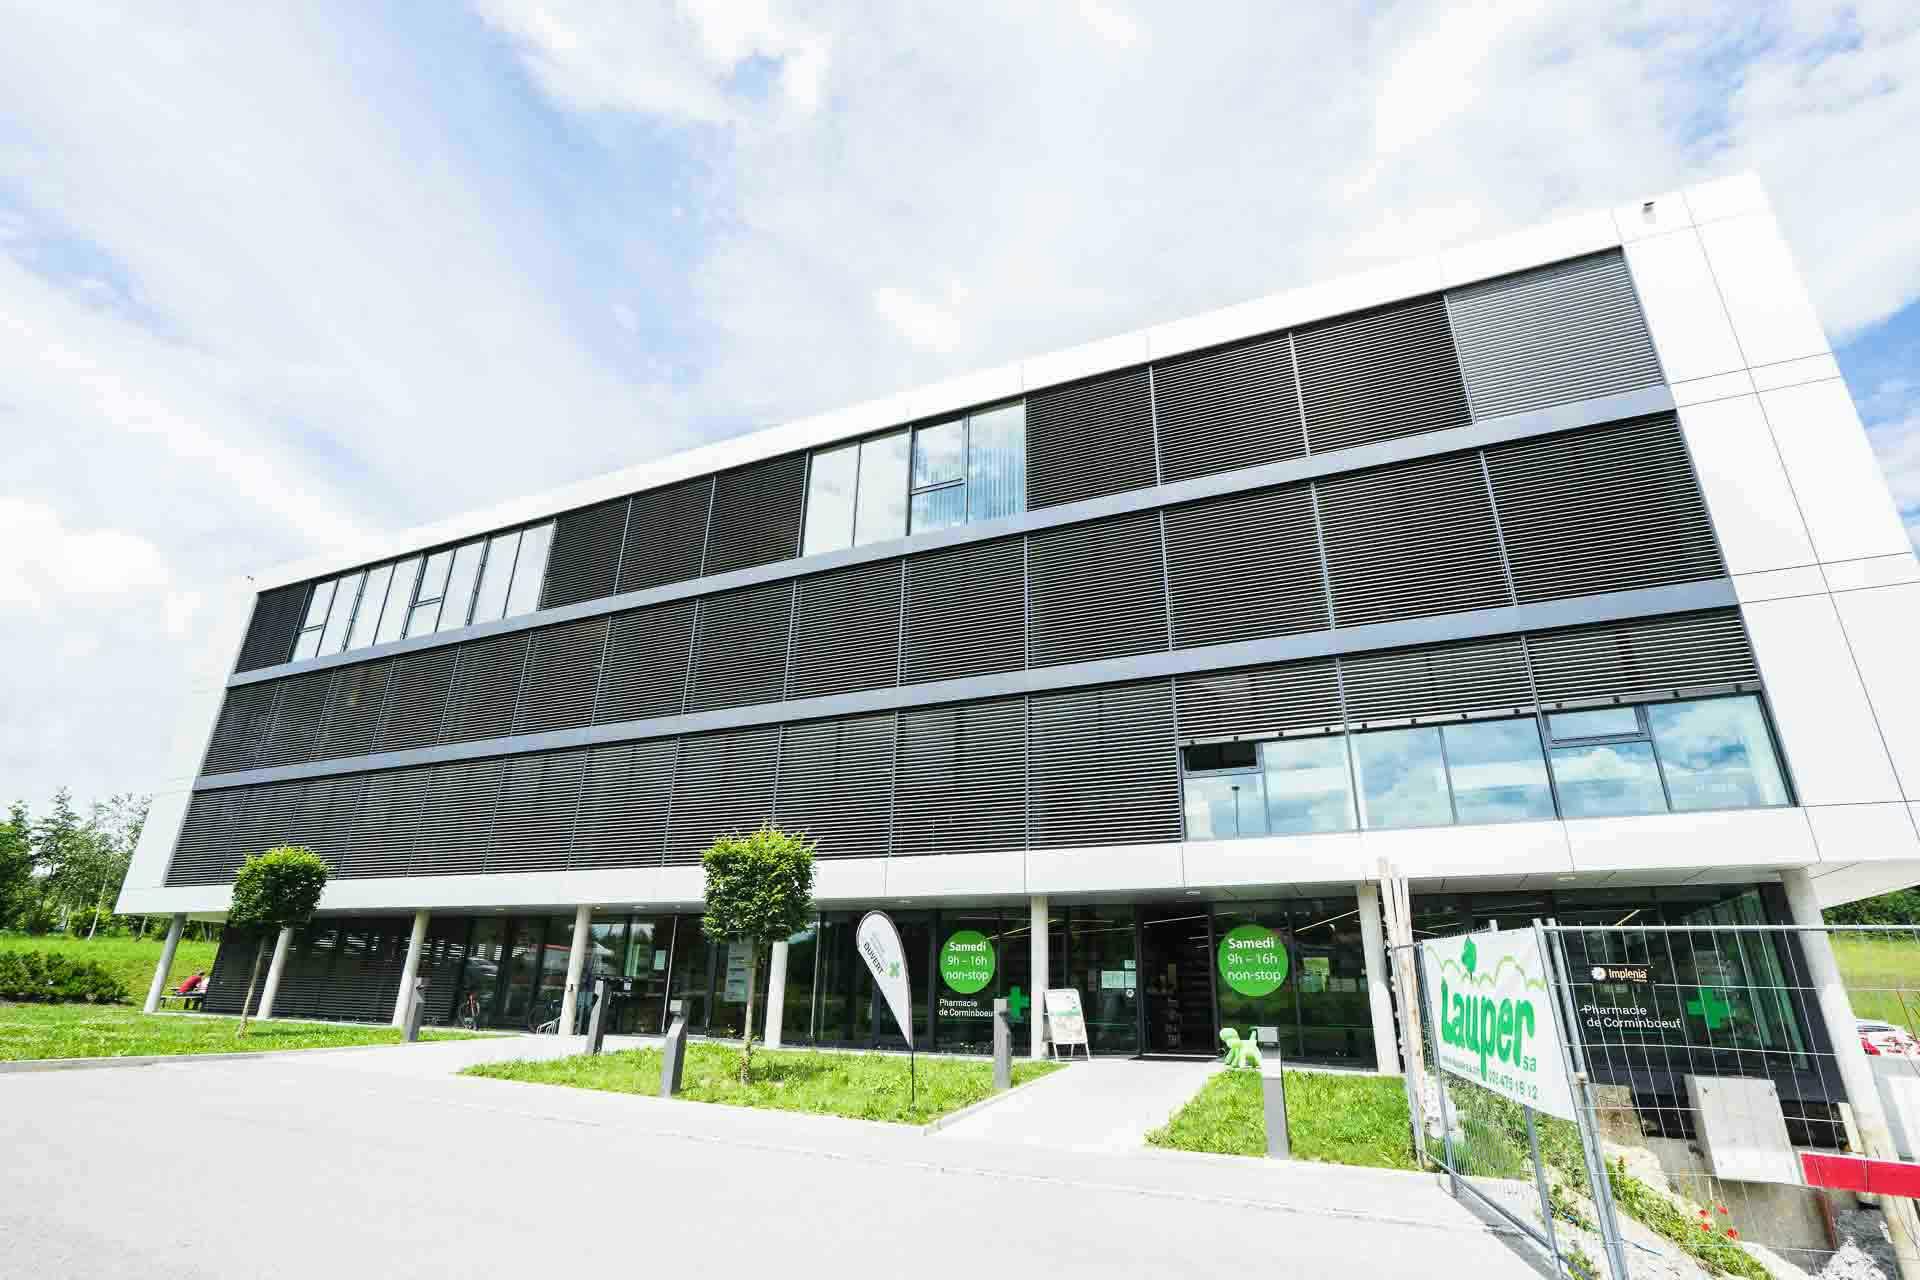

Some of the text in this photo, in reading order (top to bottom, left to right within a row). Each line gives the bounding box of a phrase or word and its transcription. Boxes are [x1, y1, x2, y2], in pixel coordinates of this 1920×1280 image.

[949, 942, 987, 951] Samedi
[1228, 937, 1275, 949] Samedi
[864, 942, 884, 975] OUVERT
[947, 955, 960, 966] 9h
[970, 955, 988, 966] 16h
[1227, 953, 1243, 965] 9h
[1255, 953, 1278, 964] 16h
[945, 970, 989, 983] non-stop
[1228, 970, 1281, 983] non-stop
[1608, 968, 1647, 981] Implenia
[939, 999, 978, 1007] Pharmacie
[938, 1008, 993, 1017] de Corminboeu
[1584, 1004, 1648, 1015] Pharmacie
[1586, 1017, 1681, 1028] de Corminboeuf
[1441, 976, 1535, 1082] Lauper
[1523, 1056, 1537, 1073] sa
